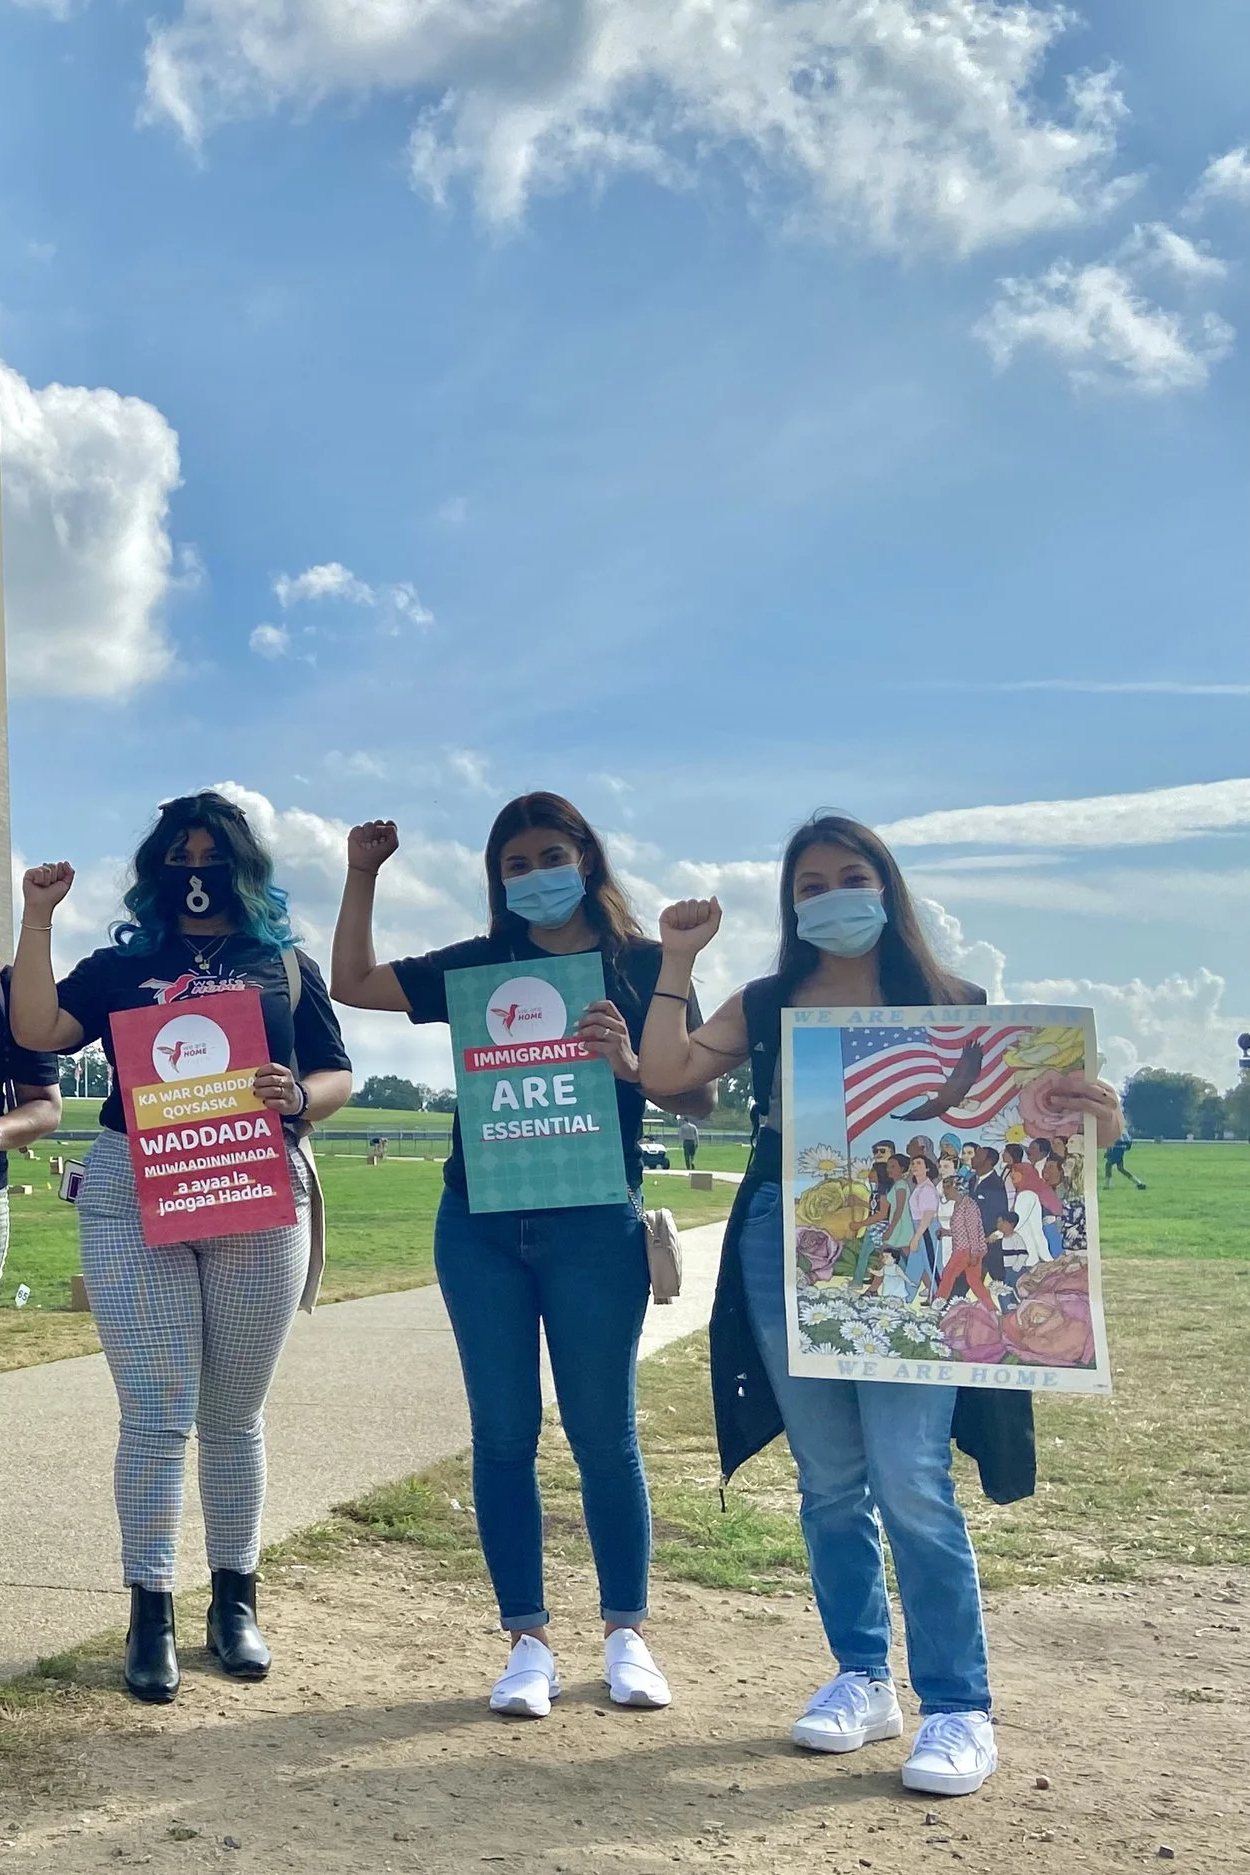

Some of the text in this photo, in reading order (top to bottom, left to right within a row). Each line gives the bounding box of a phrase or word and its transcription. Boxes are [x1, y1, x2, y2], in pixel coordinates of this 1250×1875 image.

[518, 1012, 543, 1021] HOME
[793, 1010, 832, 1023] WE
[846, 1010, 904, 1023] ARE
[184, 1048, 207, 1057] HOME
[473, 1042, 589, 1068] IMMIGRANTS
[138, 1093, 157, 1107] KA
[160, 1087, 191, 1103] WAR
[491, 1073, 578, 1112] ARE
[162, 1096, 238, 1120] QOYSASKA
[139, 1117, 272, 1156] WADDADA
[482, 1114, 600, 1141] ESSENTIAL
[144, 1147, 276, 1178] MUWAADINNIMADA
[178, 1170, 249, 1194] a ayaa la
[158, 1183, 273, 1217] joogaa Hadda
[18, 1289, 29, 1301] 65
[837, 1360, 1059, 1387] WE ARE HOME
